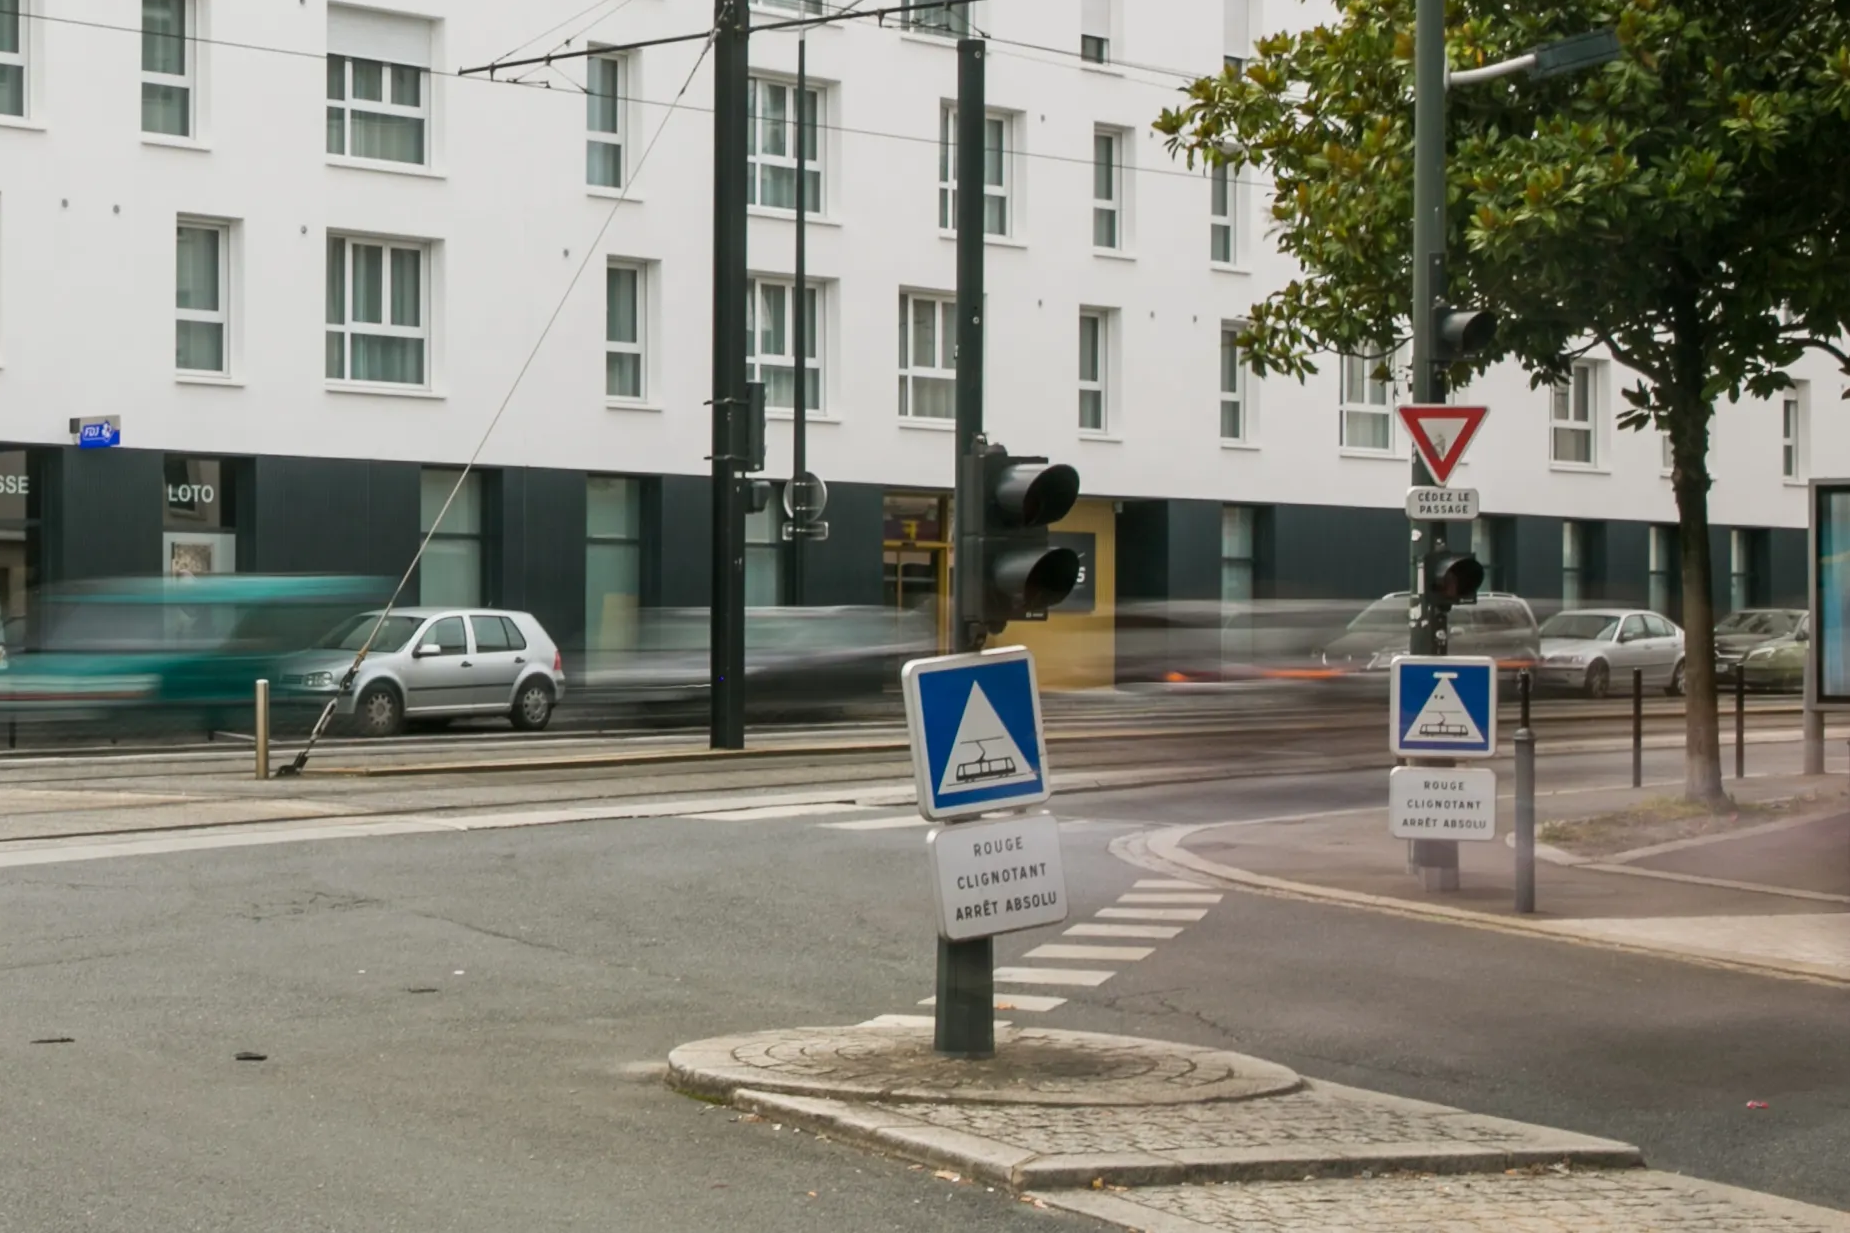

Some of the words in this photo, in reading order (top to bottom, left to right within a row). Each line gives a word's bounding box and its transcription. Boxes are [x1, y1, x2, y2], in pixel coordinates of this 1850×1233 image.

[84, 426, 99, 437] FDJ
[167, 483, 215, 504] LOTO
[1418, 491, 1452, 502] CÉDEZ
[1458, 492, 1470, 502] LE
[1419, 505, 1468, 514] PASSAGE
[1423, 780, 1465, 791] ROUGE
[1406, 799, 1482, 810] CLIGNOTANT
[1402, 817, 1438, 828] ARRÊT
[1443, 819, 1487, 830] ABSOLU
[973, 836, 1023, 857] ROUGE
[957, 862, 1046, 890] CLIGNOTANT
[955, 899, 998, 921] ARRÊT
[1005, 891, 1057, 912] ABSOLU
